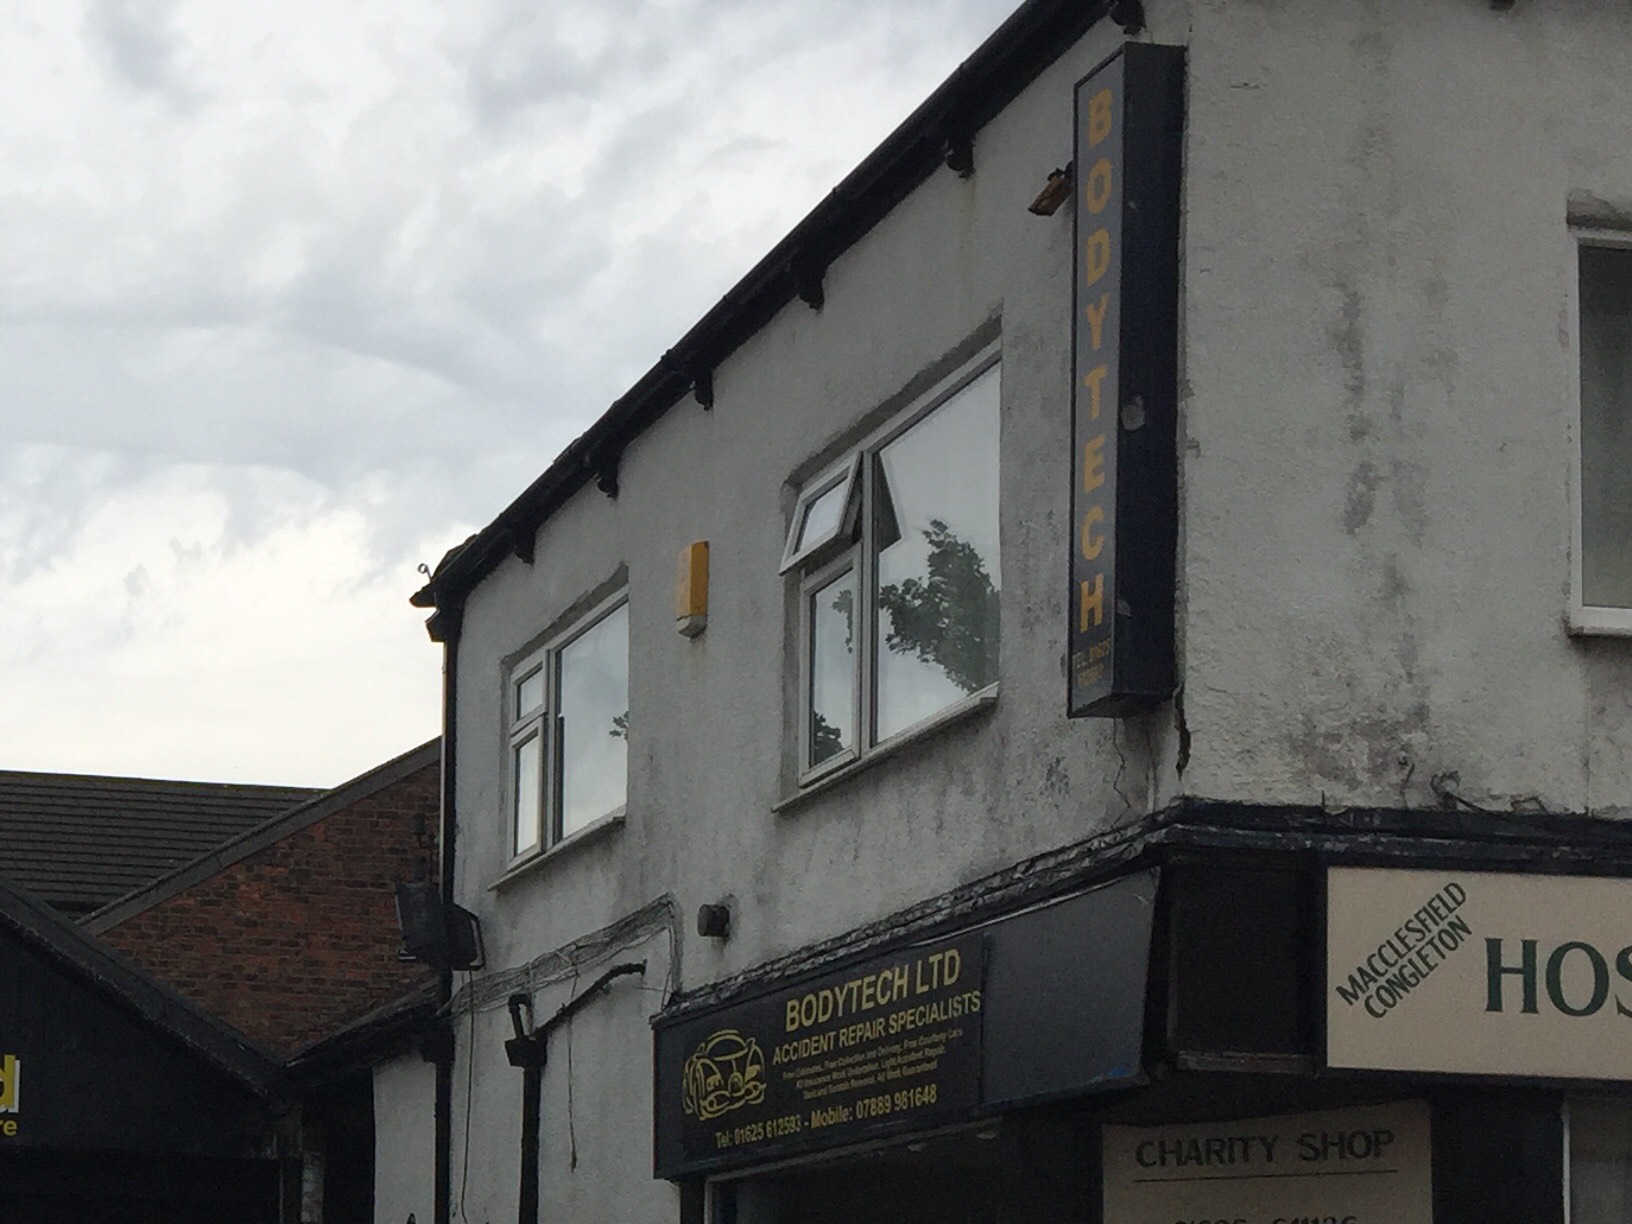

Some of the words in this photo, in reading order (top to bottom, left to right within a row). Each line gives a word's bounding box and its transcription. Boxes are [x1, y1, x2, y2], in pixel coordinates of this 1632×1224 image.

[1079, 87, 1113, 634] BODYTECH
[1334, 881, 1467, 1006] MACCLESFIELD
[1363, 914, 1473, 1018] CONGLETON
[772, 1030, 838, 1066] ACCIDENT
[838, 1019, 886, 1049] REPAIR
[888, 990, 982, 1035] SPECIALISTS
[784, 962, 911, 1033] BODYTECH
[915, 948, 962, 995] LTD
[734, 1121, 765, 1145] 01625
[810, 1106, 854, 1130] Mobile:
[1135, 1133, 1279, 1168] CHARITY
[1297, 1128, 1395, 1163] SHOP
